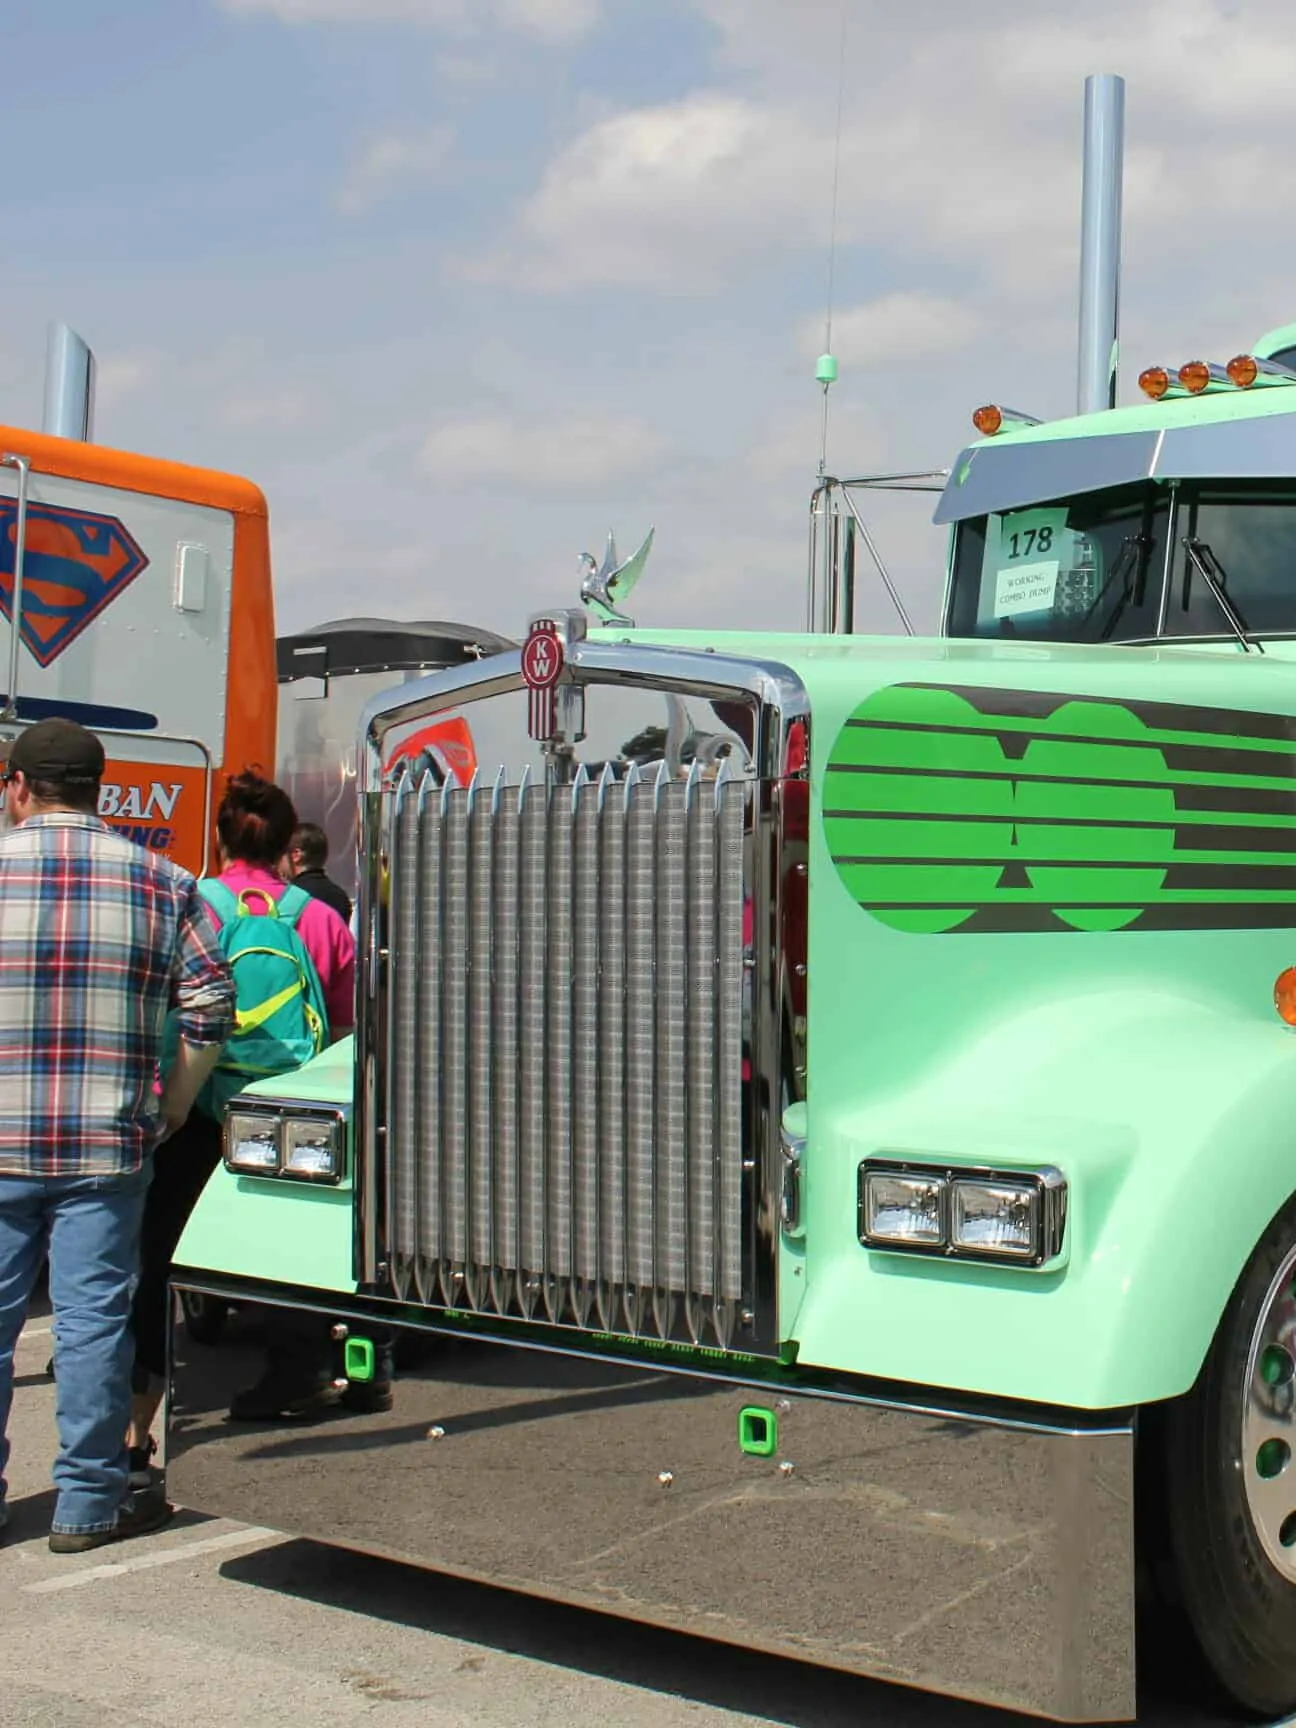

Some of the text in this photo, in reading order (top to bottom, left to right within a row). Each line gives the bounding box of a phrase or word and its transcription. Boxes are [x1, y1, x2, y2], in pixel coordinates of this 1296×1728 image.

[1007, 526, 1054, 560] 178
[535, 641, 549, 659] K
[532, 659, 551, 678] W
[97, 782, 183, 820] BAN
